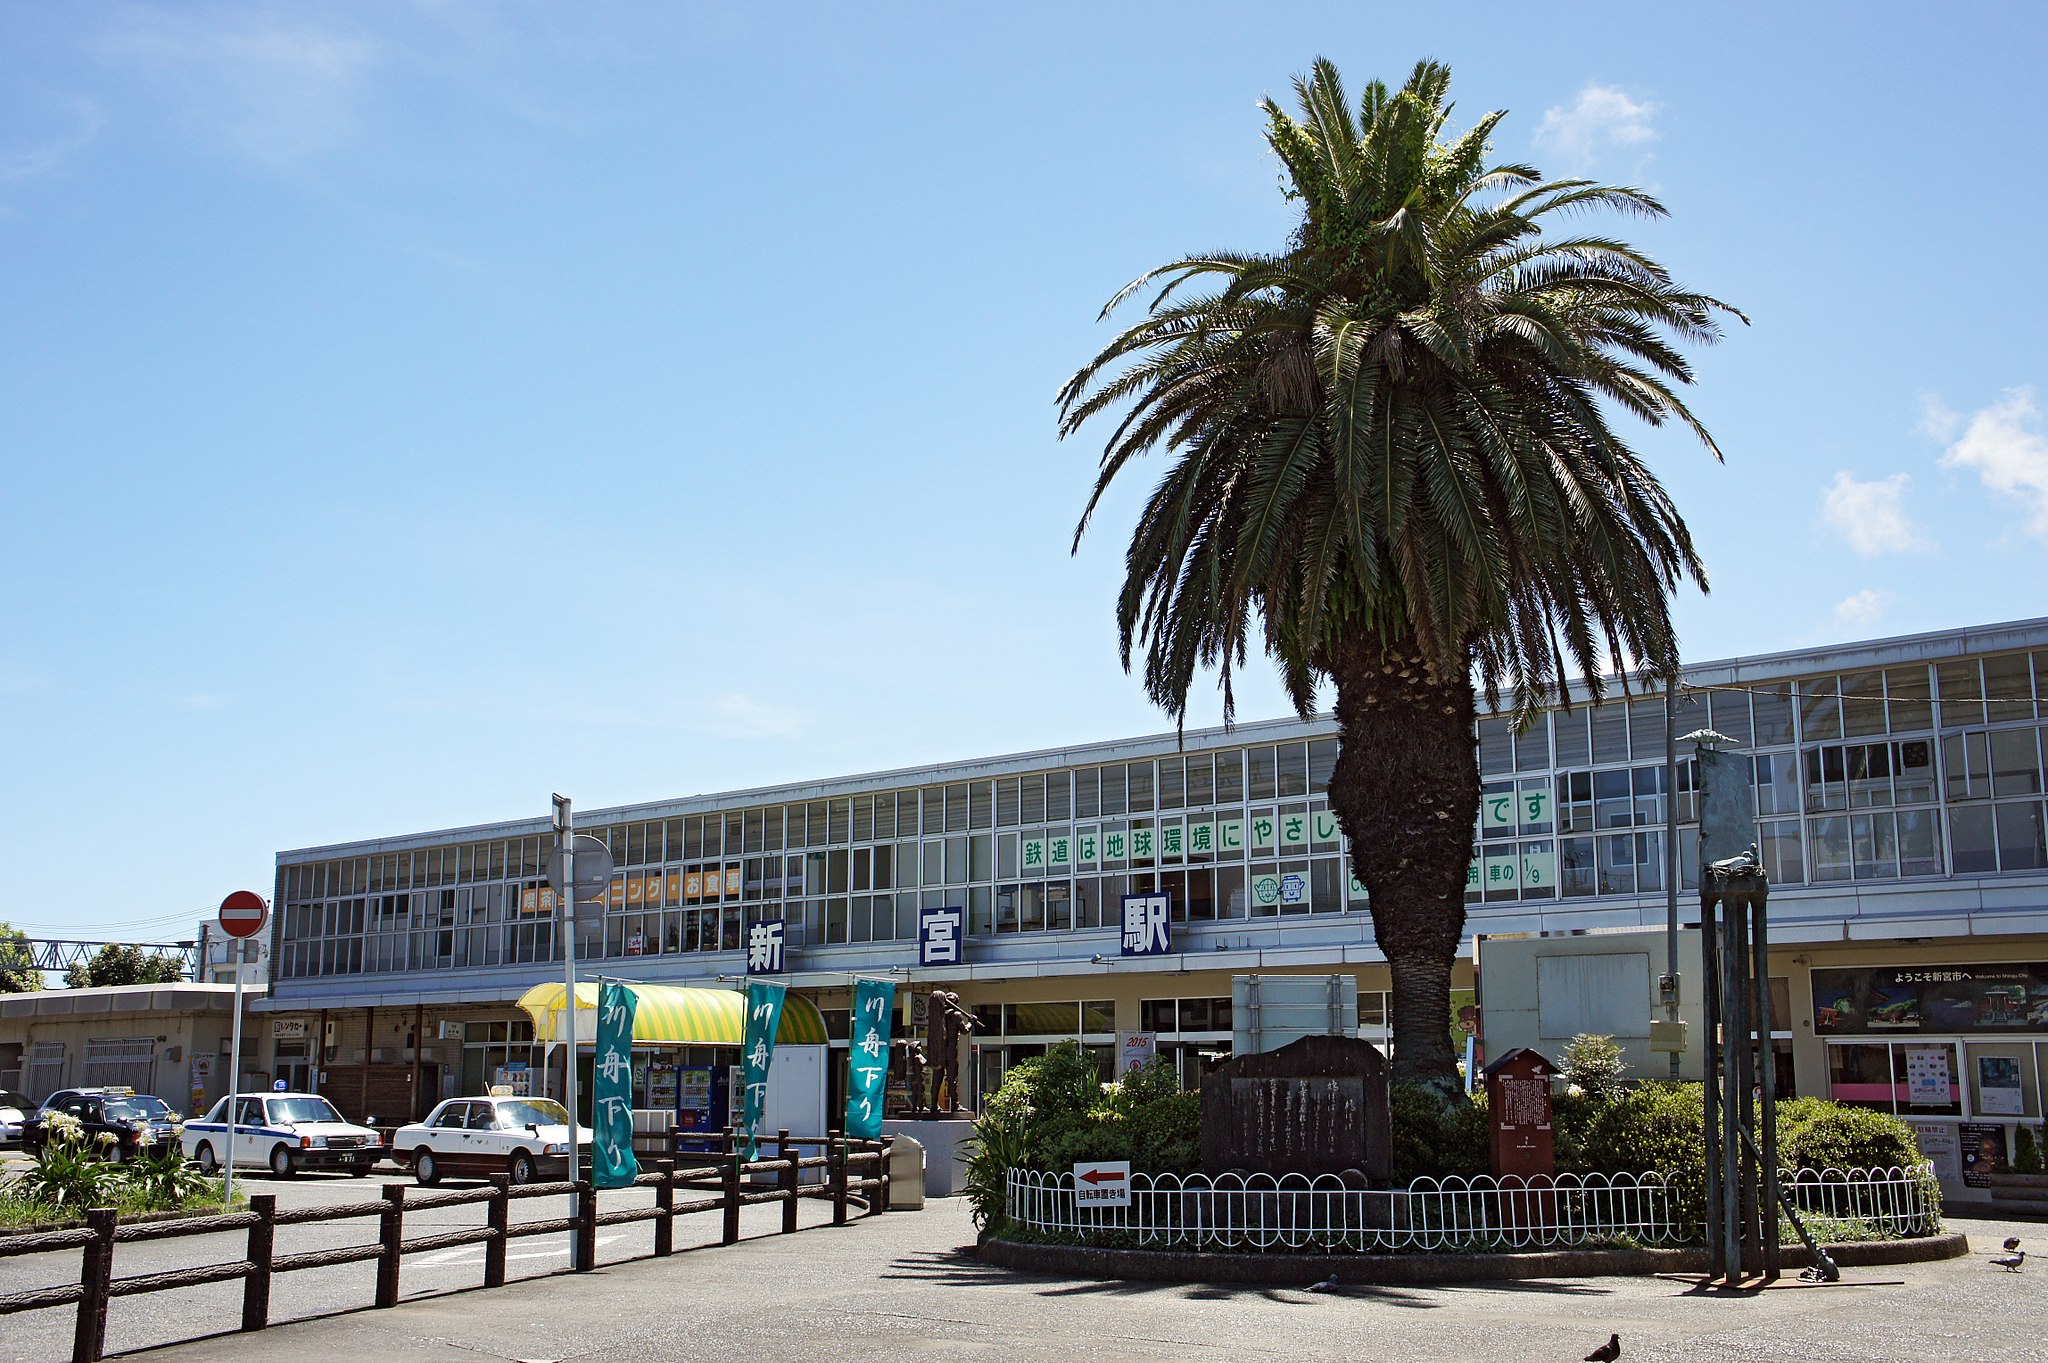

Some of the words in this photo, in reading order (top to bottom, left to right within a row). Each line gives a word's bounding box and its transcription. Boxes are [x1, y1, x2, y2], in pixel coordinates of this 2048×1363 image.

[1895, 971, 1972, 983] ようこそ新宮市へ
[1126, 1036, 1149, 1048] 2015
[857, 996, 888, 1122] 川舟下り
[597, 1005, 629, 1170] 川舟下り
[1079, 1188, 1126, 1200] 自転車置き場
